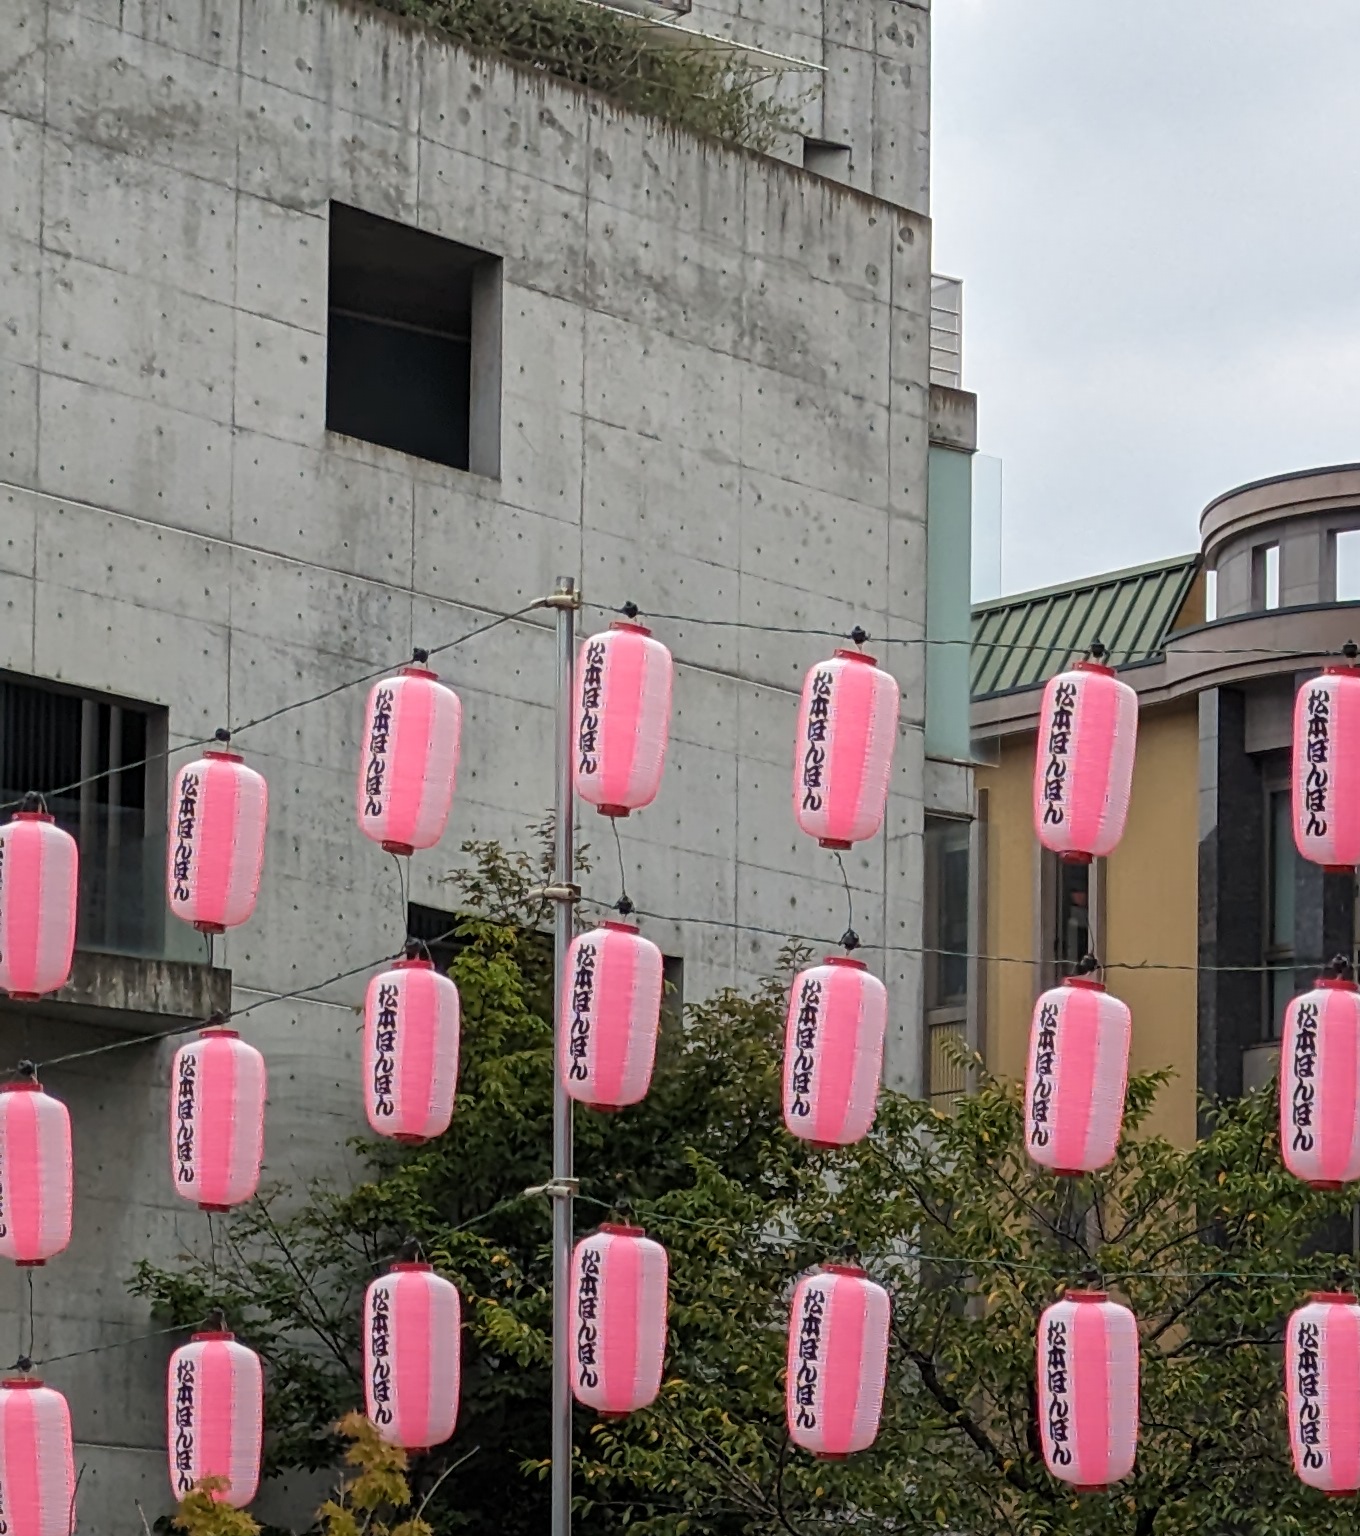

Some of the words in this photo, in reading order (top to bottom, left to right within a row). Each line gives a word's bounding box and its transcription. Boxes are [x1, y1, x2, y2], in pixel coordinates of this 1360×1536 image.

[1043, 682, 1077, 825] 松本ぼんぼん
[1305, 689, 1330, 837] 松本ぼんぼん
[1031, 1003, 1057, 1147] 松本ぼんぼん
[1292, 1003, 1319, 1152] 松本ぼんぼん
[1046, 1320, 1072, 1466] 松本ぼんぼん
[1297, 1322, 1324, 1469] 松本ぼんぼん
